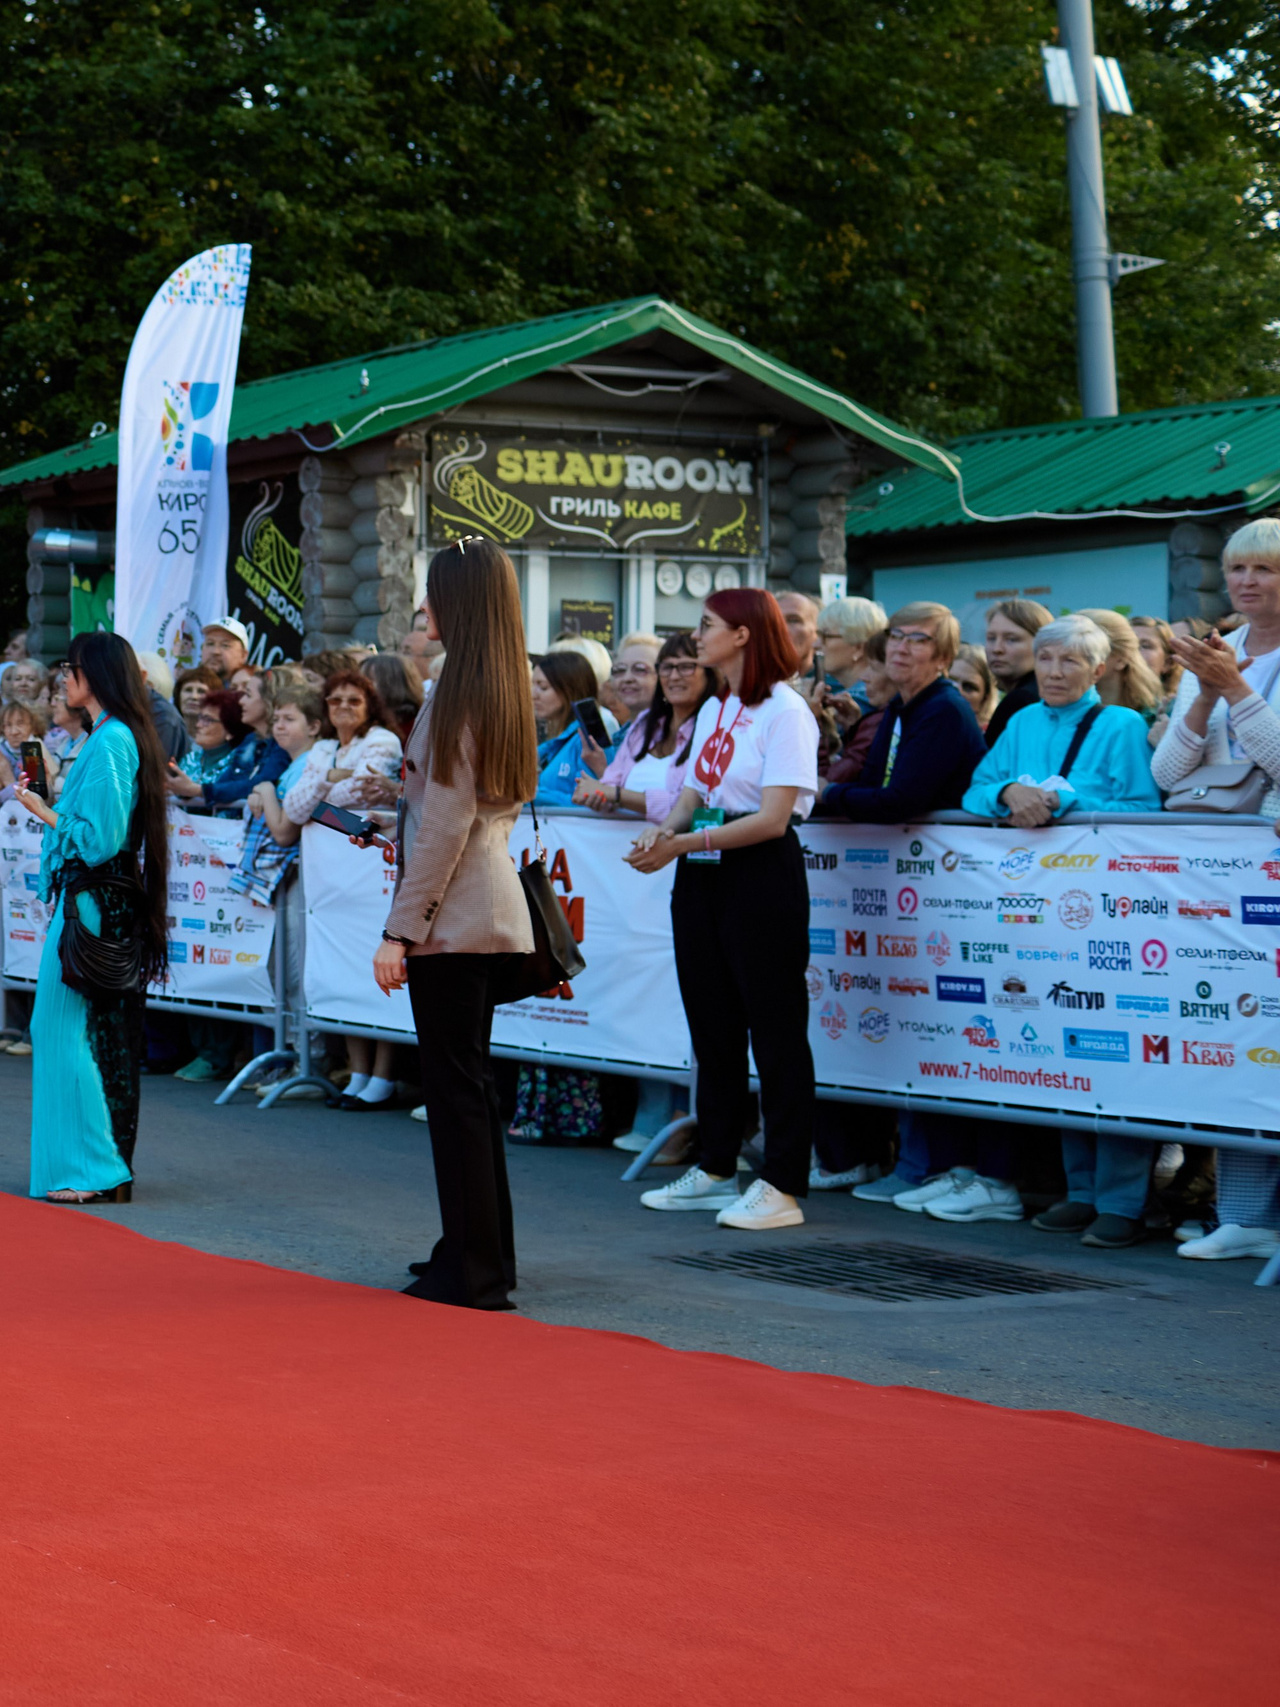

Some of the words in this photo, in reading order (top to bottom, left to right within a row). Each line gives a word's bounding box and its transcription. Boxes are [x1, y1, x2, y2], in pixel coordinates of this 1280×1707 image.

[496, 448, 753, 495] SHAUROOM
[158, 493, 206, 512] КИРО
[550, 496, 621, 518] ГРИЛЬ
[624, 501, 682, 521] КАФЕ
[158, 520, 200, 554] 65
[896, 859, 935, 876] ВЯТИЧ
[998, 851, 1036, 872] МОРЕ
[852, 888, 887, 903] ПОЧТА
[853, 903, 887, 917] РОССИИ
[1246, 903, 1280, 914] KIROV
[972, 941, 1010, 954] COFFEE
[1088, 940, 1131, 956] ПОЧТА
[972, 952, 994, 964] LIKE
[1089, 956, 1132, 971] РОССИИ
[940, 982, 982, 993] KIROV.RU
[1180, 1000, 1230, 1021] ВЯТИЧ
[858, 1013, 891, 1034] МОРЕ
[1009, 1042, 1055, 1056] PATRON
[919, 1061, 1092, 1093] www.7-holmovfest.ru
